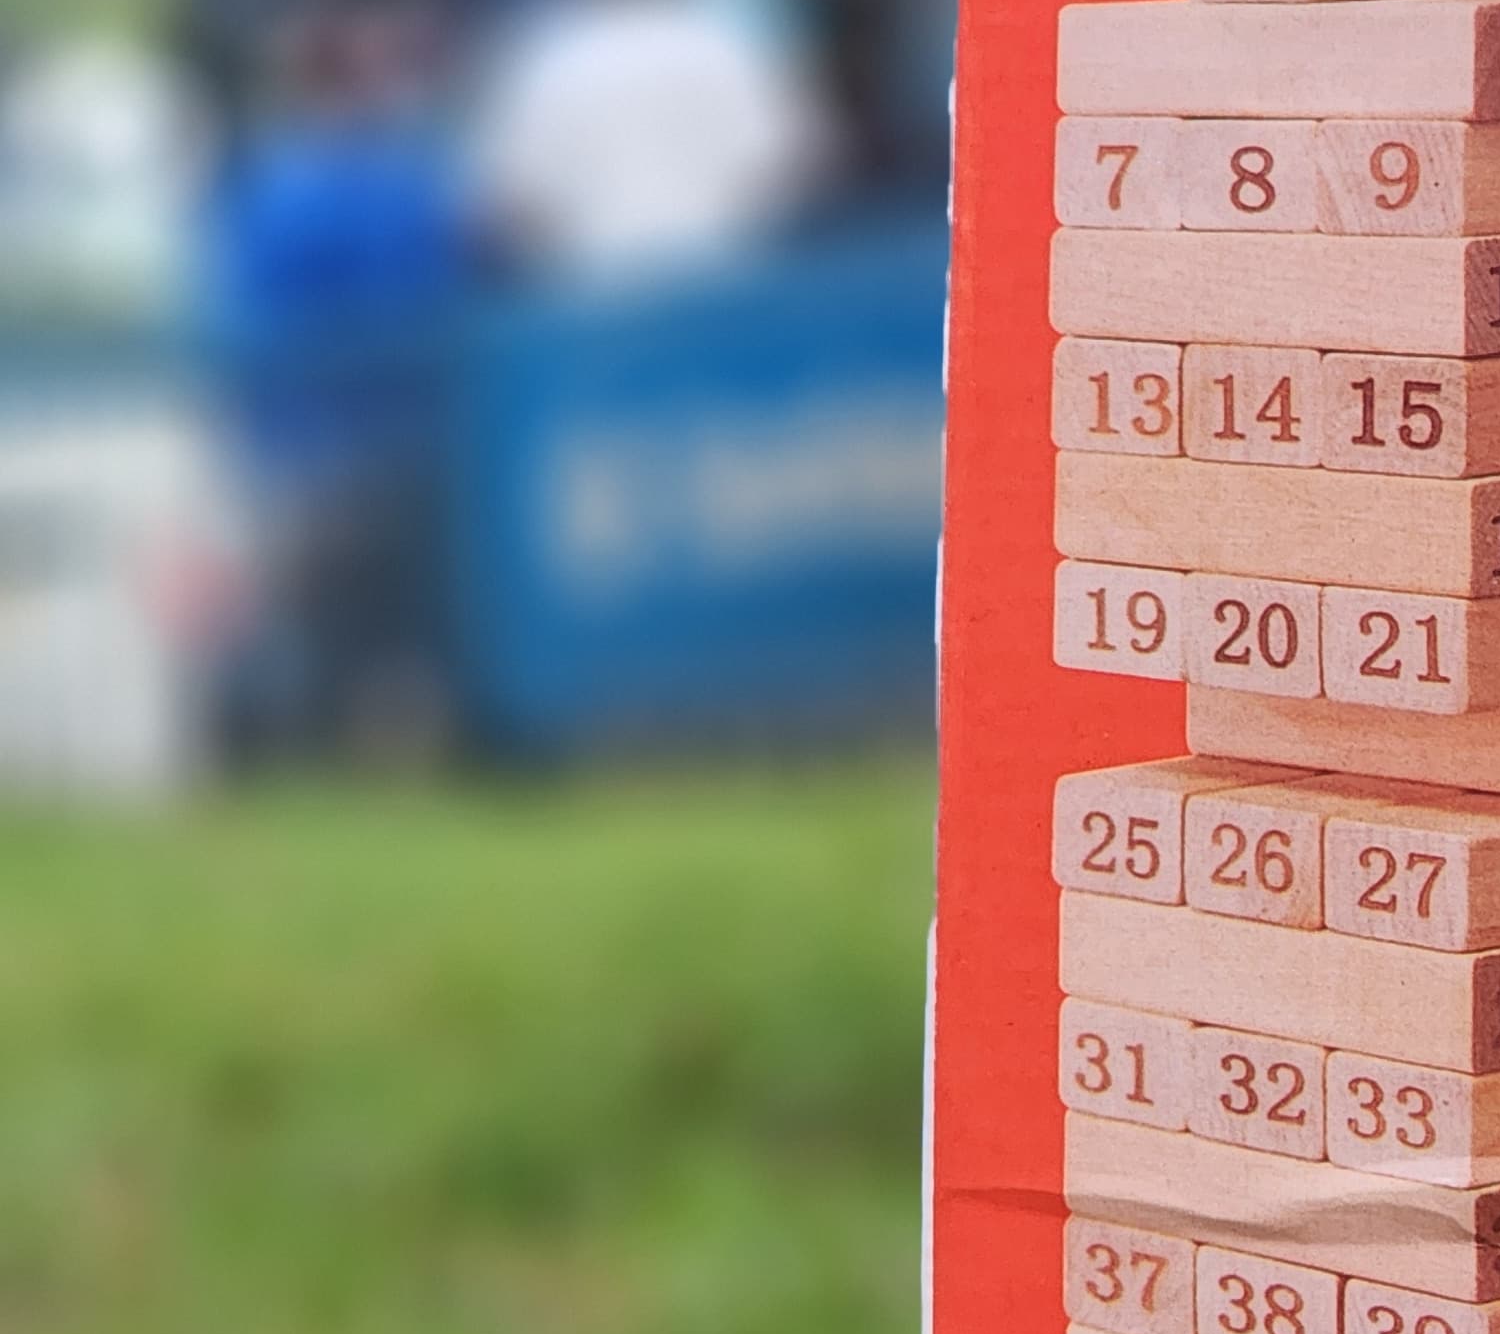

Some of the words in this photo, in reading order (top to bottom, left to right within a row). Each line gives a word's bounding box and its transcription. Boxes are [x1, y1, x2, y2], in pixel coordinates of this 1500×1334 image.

[1096, 145, 1140, 210] 7
[1229, 146, 1277, 212] 8
[1369, 143, 1421, 209] 9
[1086, 373, 1174, 436] 13
[1211, 375, 1301, 445] 14
[1350, 379, 1445, 451] 15
[1085, 586, 1169, 653] 19
[1213, 600, 1299, 668] 20
[1359, 613, 1452, 683] 21
[1080, 810, 1162, 879] 25
[1210, 823, 1296, 893] 26
[1358, 848, 1448, 918] 27
[1073, 1033, 1156, 1105] 31
[1221, 1053, 1308, 1127] 32
[1347, 1076, 1436, 1150] 33
[1085, 1243, 1171, 1315] 37
